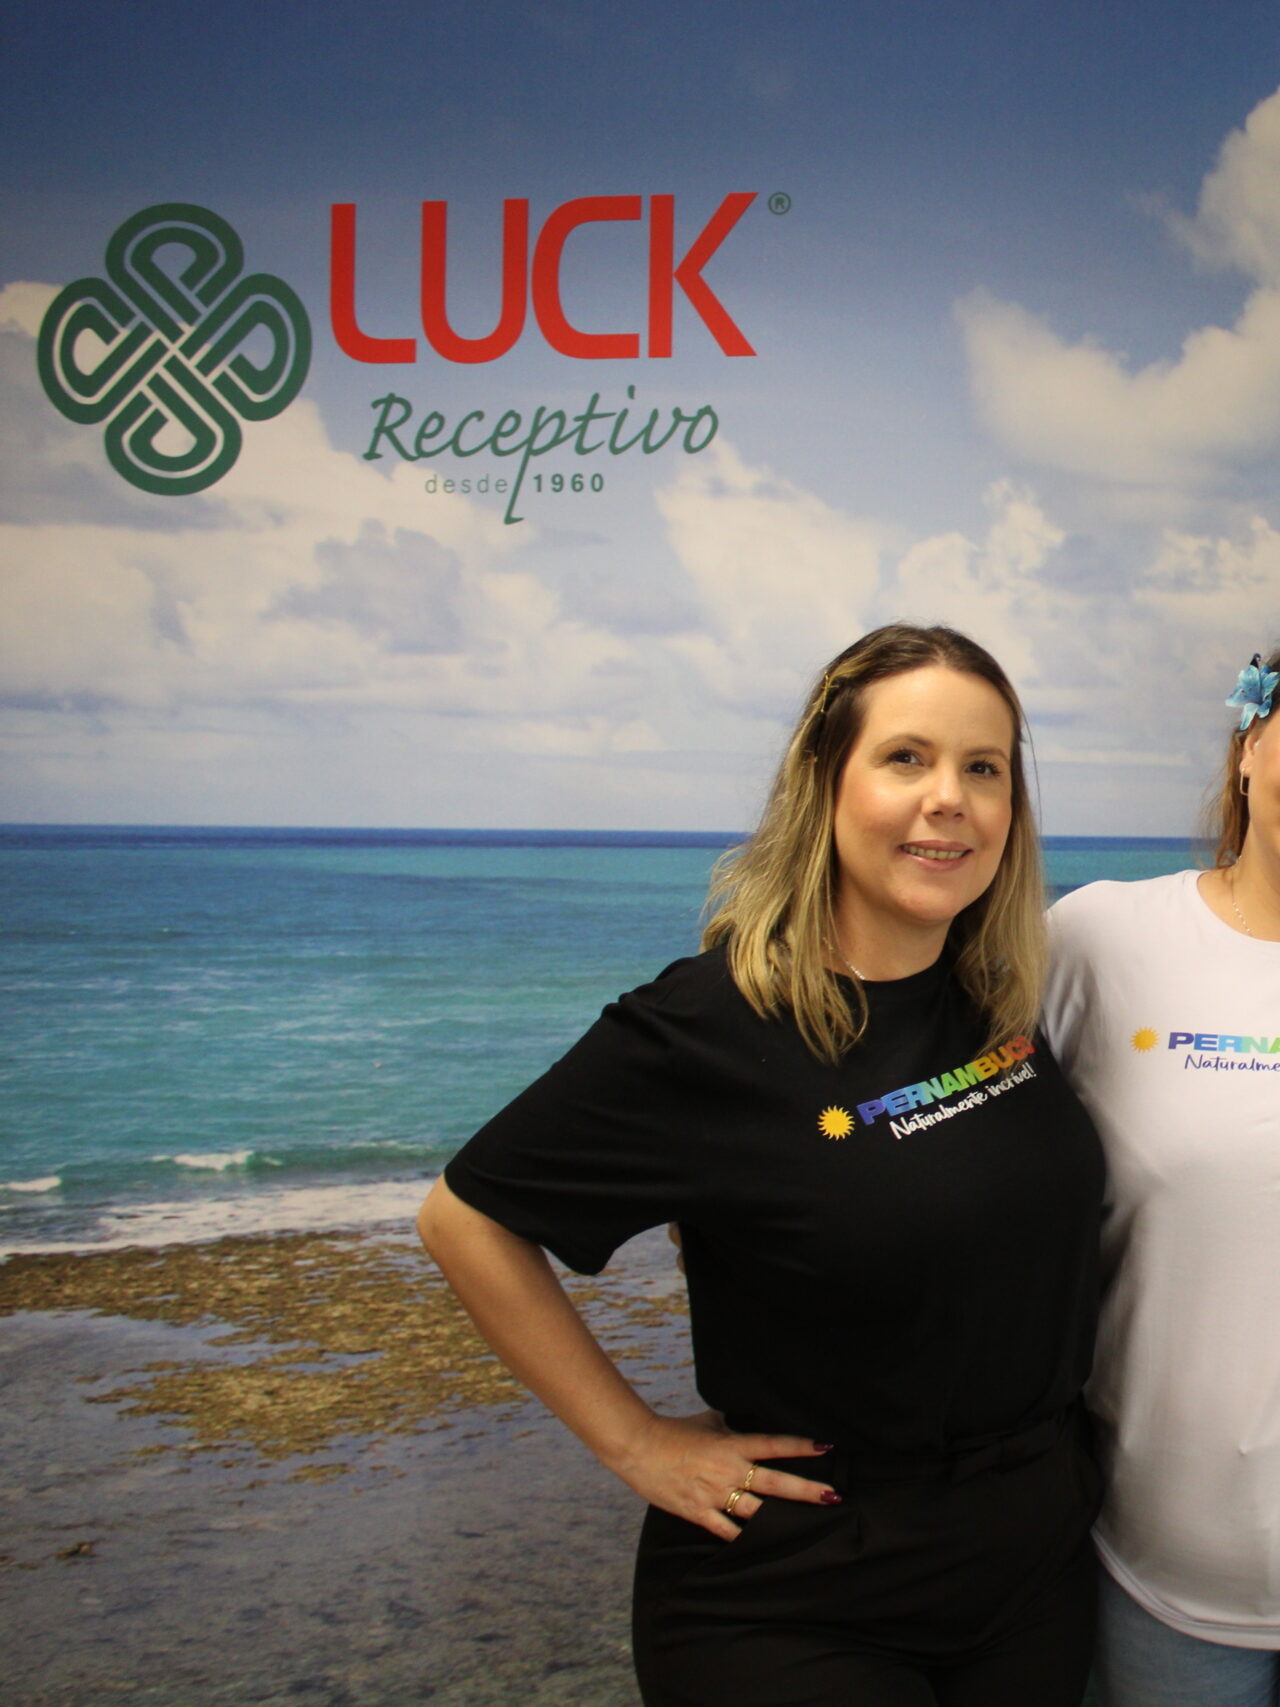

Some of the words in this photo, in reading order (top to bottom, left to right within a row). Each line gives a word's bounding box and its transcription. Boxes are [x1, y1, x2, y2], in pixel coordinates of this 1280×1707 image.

[330, 192, 759, 364] LUCK
[362, 385, 719, 525] Receptivo
[425, 475, 508, 494] desde
[533, 473, 604, 493] 1960
[889, 1090, 988, 1140] Naturalmente
[987, 1061, 1038, 1096] incrível!
